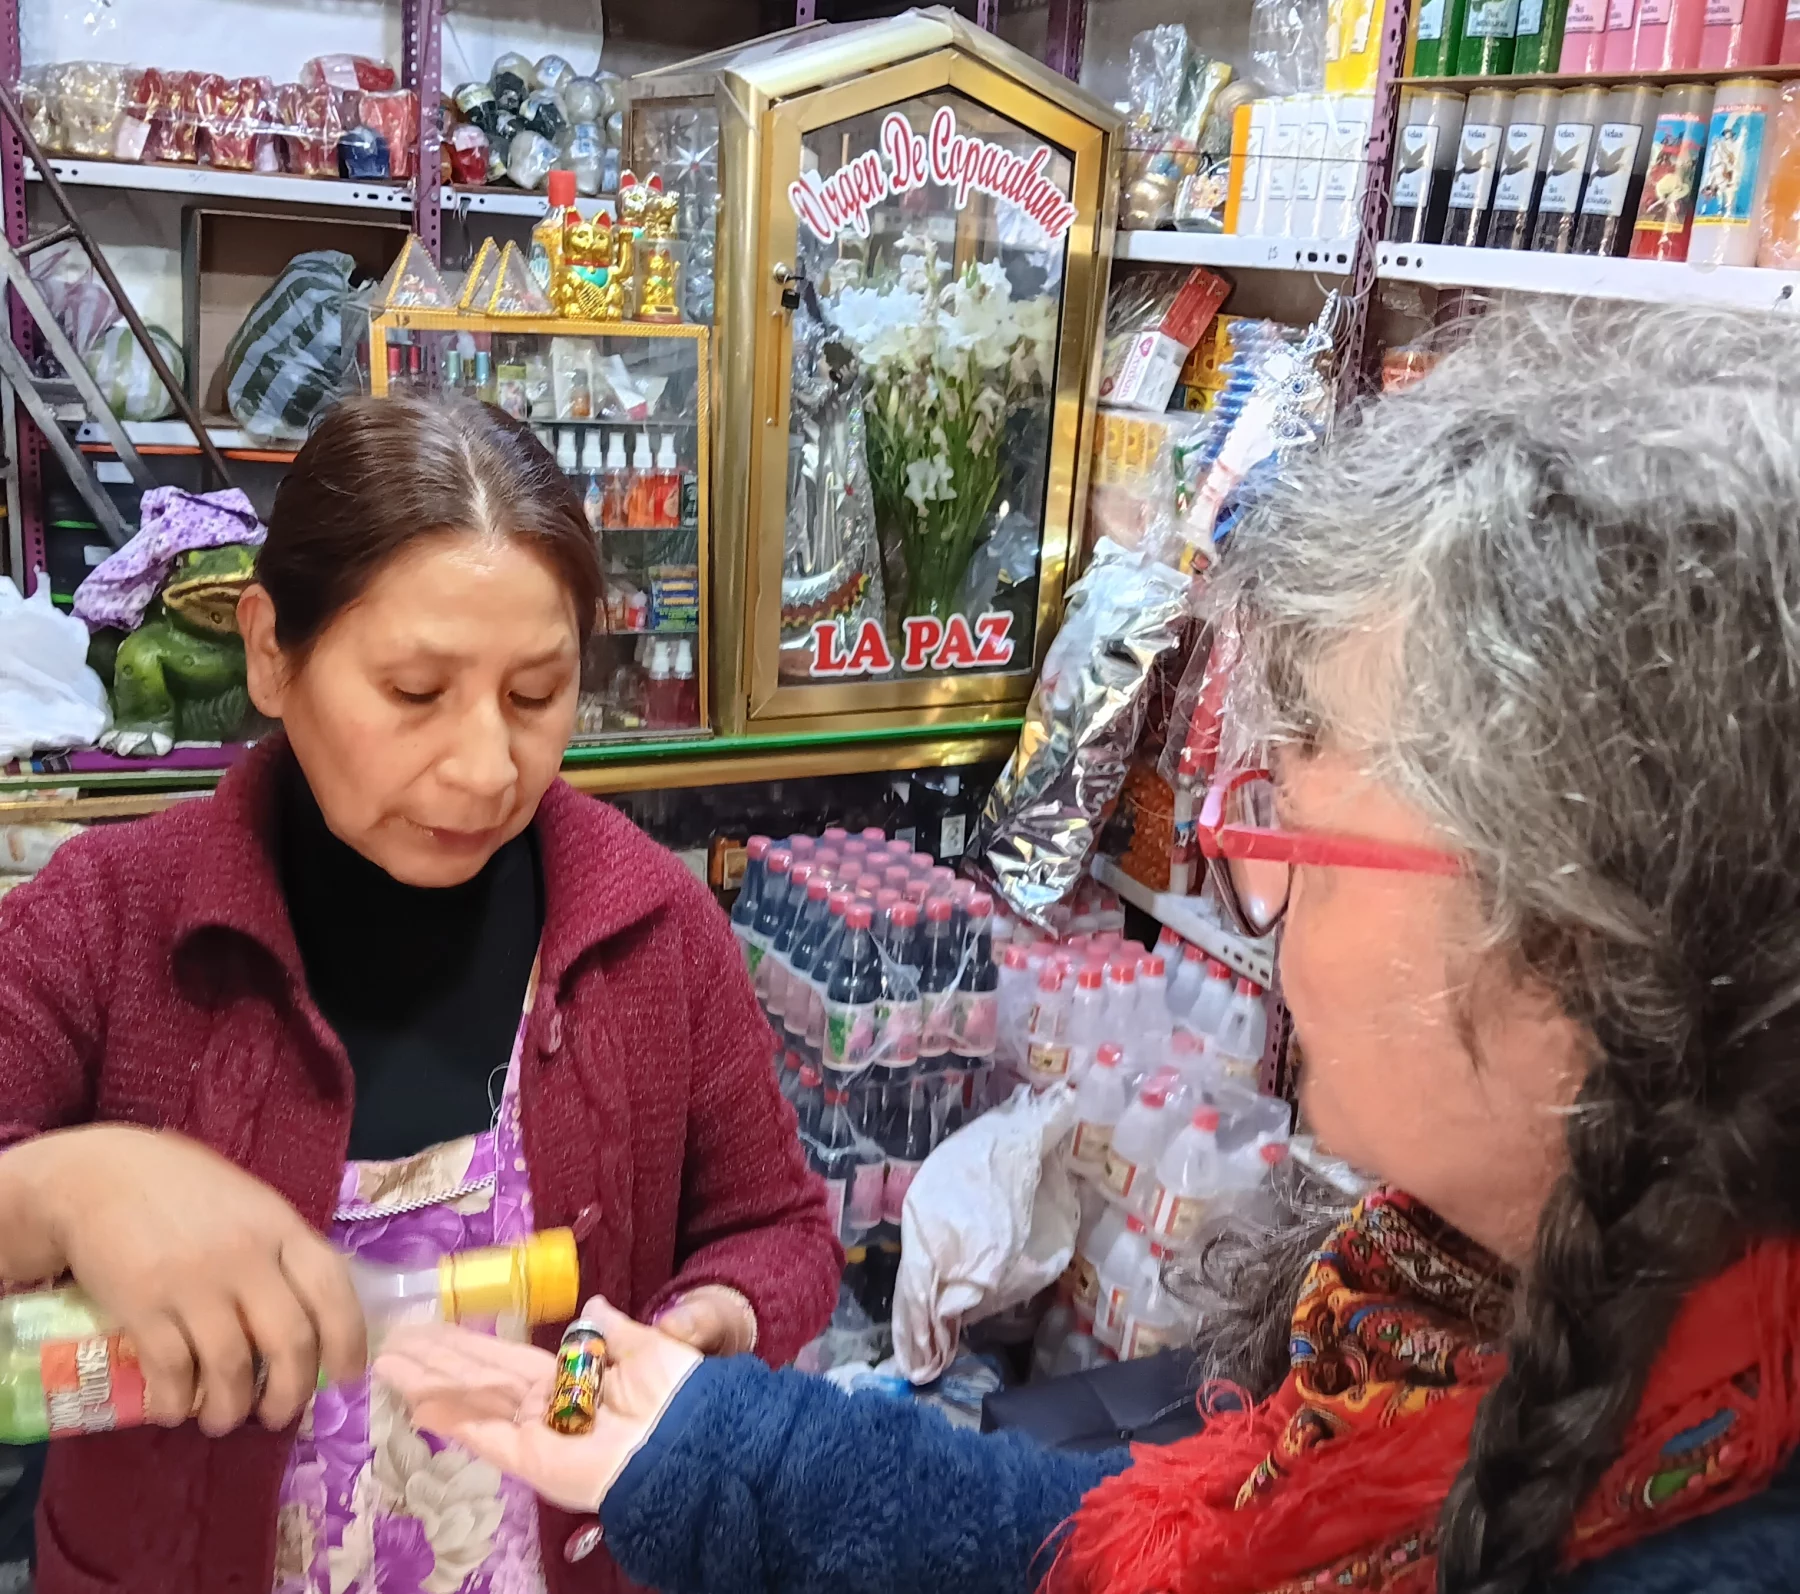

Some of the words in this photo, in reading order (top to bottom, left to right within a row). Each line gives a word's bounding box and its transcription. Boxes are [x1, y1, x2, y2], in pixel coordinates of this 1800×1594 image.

[790, 152, 886, 242] Virgen
[883, 114, 927, 191] De
[931, 108, 1077, 238] Copacabana
[811, 619, 893, 675] LA
[903, 612, 1014, 668] PAZ
